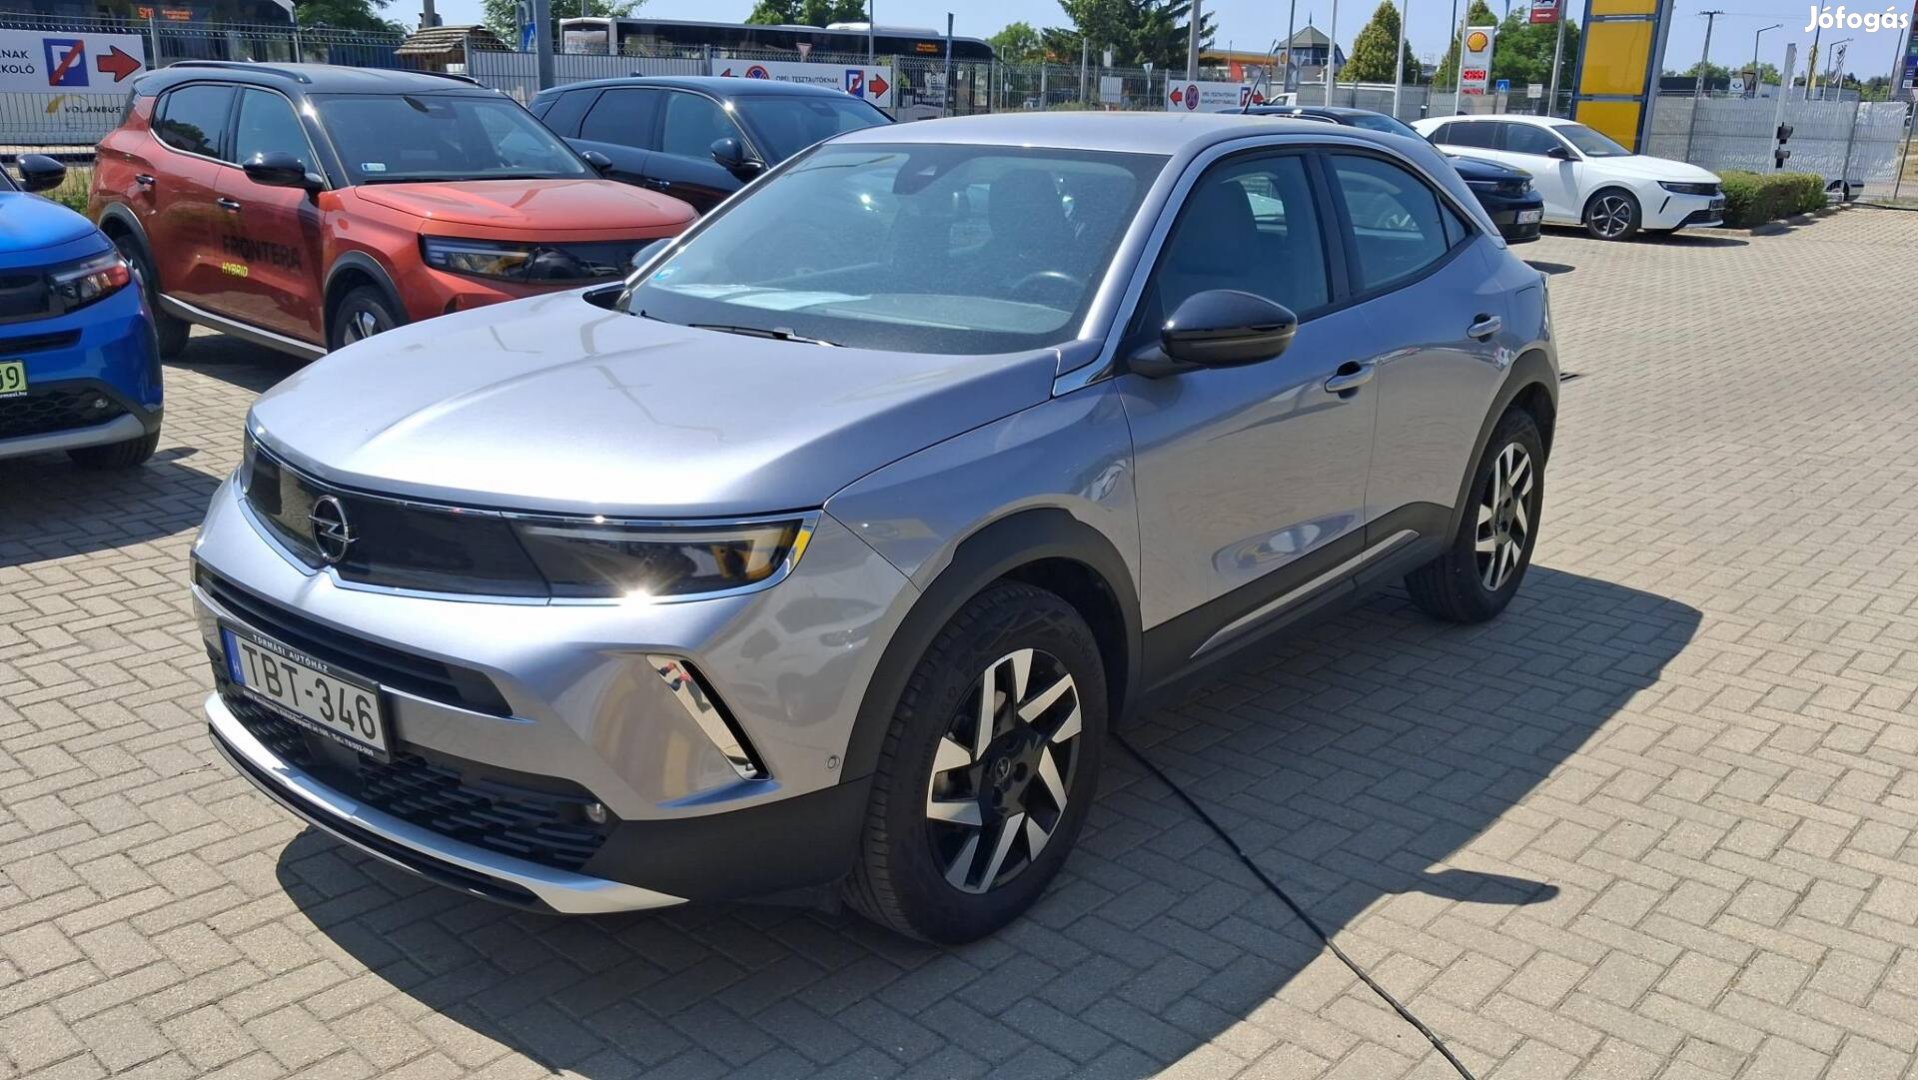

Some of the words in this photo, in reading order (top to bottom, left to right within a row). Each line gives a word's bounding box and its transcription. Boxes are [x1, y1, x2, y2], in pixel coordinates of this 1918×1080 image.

[0, 49, 30, 59] NAK
[0, 63, 35, 75] KOLÓ
[222, 235, 302, 270] FRONTERA
[222, 262, 249, 279] HYBRID
[233, 661, 241, 675] H
[242, 643, 377, 740] TBT-346
